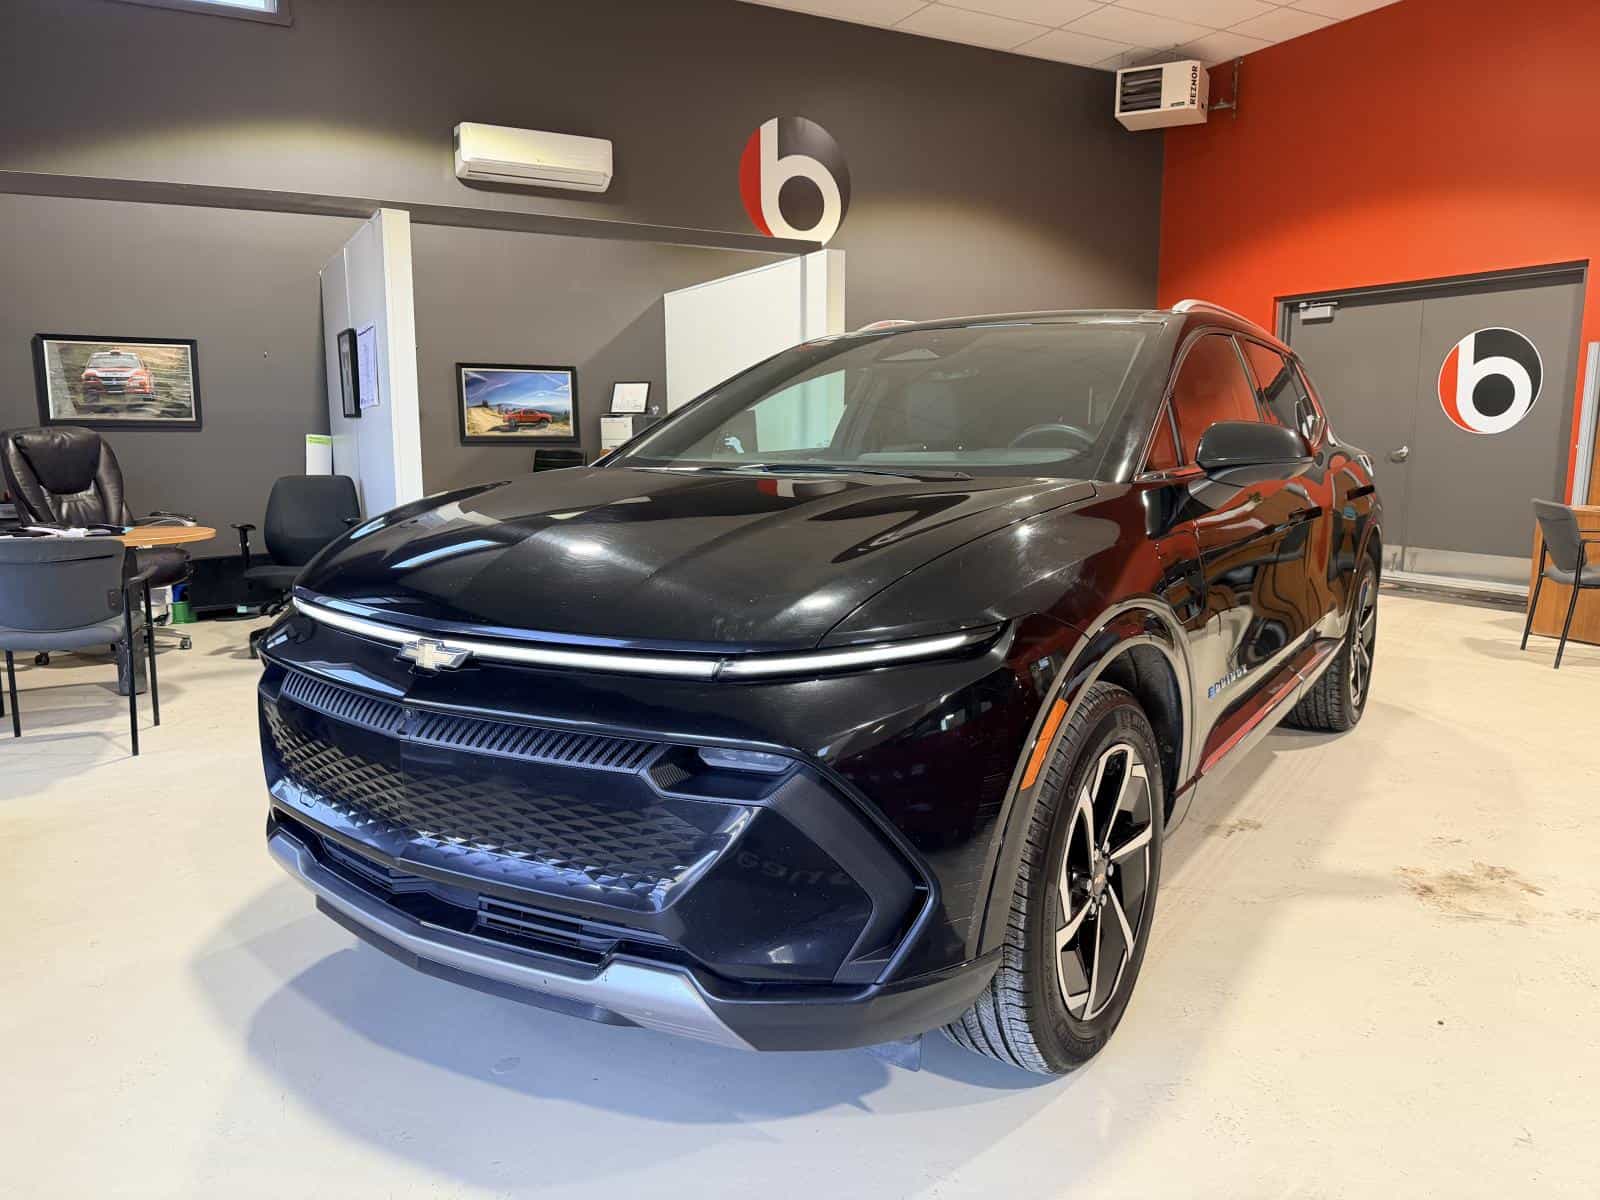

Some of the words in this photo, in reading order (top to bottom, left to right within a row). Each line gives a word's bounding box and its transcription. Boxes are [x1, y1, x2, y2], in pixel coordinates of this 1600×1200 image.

[1190, 65, 1199, 105] REZNOR
[760, 117, 842, 246] b
[1456, 331, 1533, 435] b
